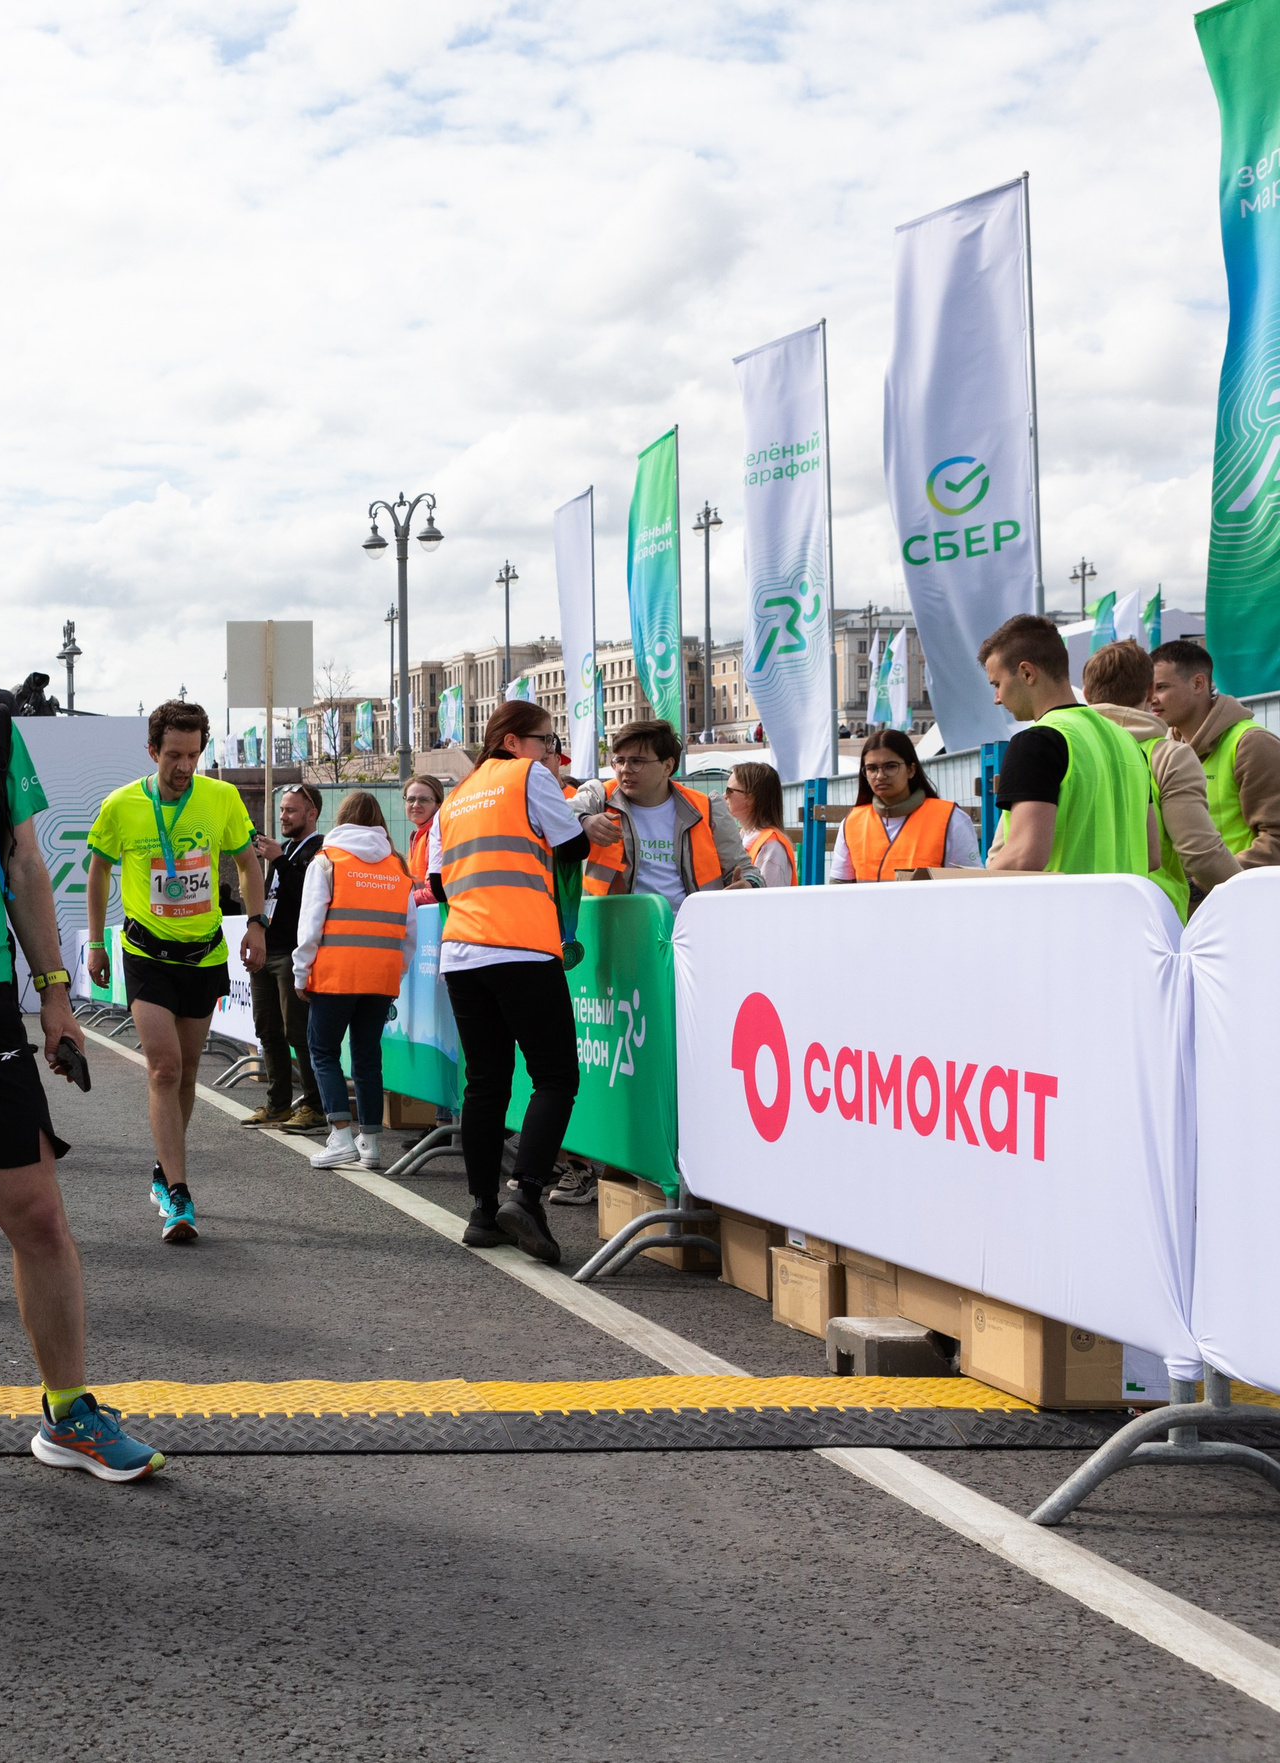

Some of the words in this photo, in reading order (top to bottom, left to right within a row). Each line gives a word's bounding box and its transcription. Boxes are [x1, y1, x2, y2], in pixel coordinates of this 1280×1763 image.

[745, 430, 820, 467] елёный
[902, 519, 1021, 566] СБЕР
[574, 695, 595, 720] СБЕ
[347, 871, 401, 882] СПОРТИВНЫЙ
[355, 880, 396, 890] ВОЛОНТЁР
[573, 985, 615, 1026] лёный
[577, 1026, 610, 1074] афон
[803, 1041, 1059, 1162] самокат
